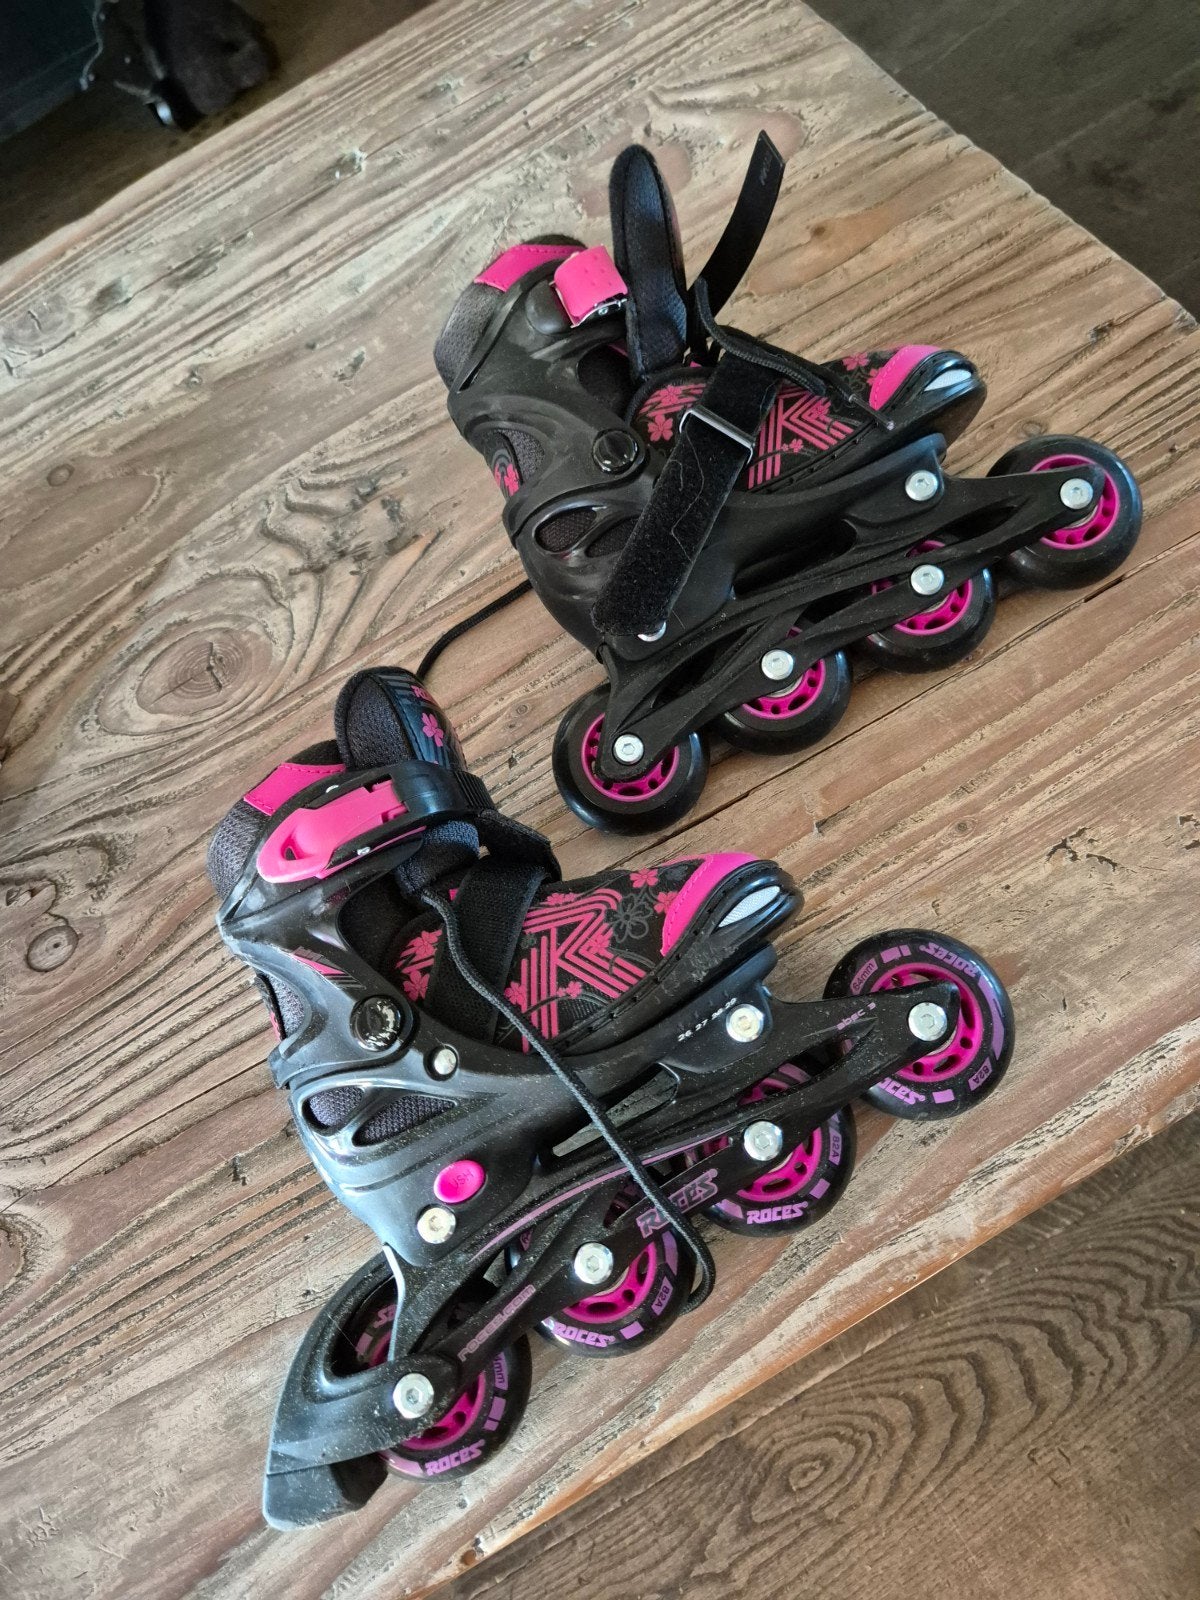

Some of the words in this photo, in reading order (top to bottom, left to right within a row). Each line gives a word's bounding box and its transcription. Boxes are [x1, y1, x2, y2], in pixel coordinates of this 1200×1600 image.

[920, 941, 979, 978] ROCES
[852, 963, 875, 991] 64mm
[836, 1008, 866, 1031] abec
[971, 1064, 991, 1085] 82A
[878, 1076, 926, 1105] OCES
[831, 1134, 841, 1158] 82A
[746, 1200, 809, 1225] ROCES
[654, 1284, 670, 1308] 82A
[457, 1284, 537, 1362] roces.com
[551, 1321, 616, 1348] ROCES
[493, 1357, 506, 1384] mm
[424, 1438, 485, 1477] ROCES
